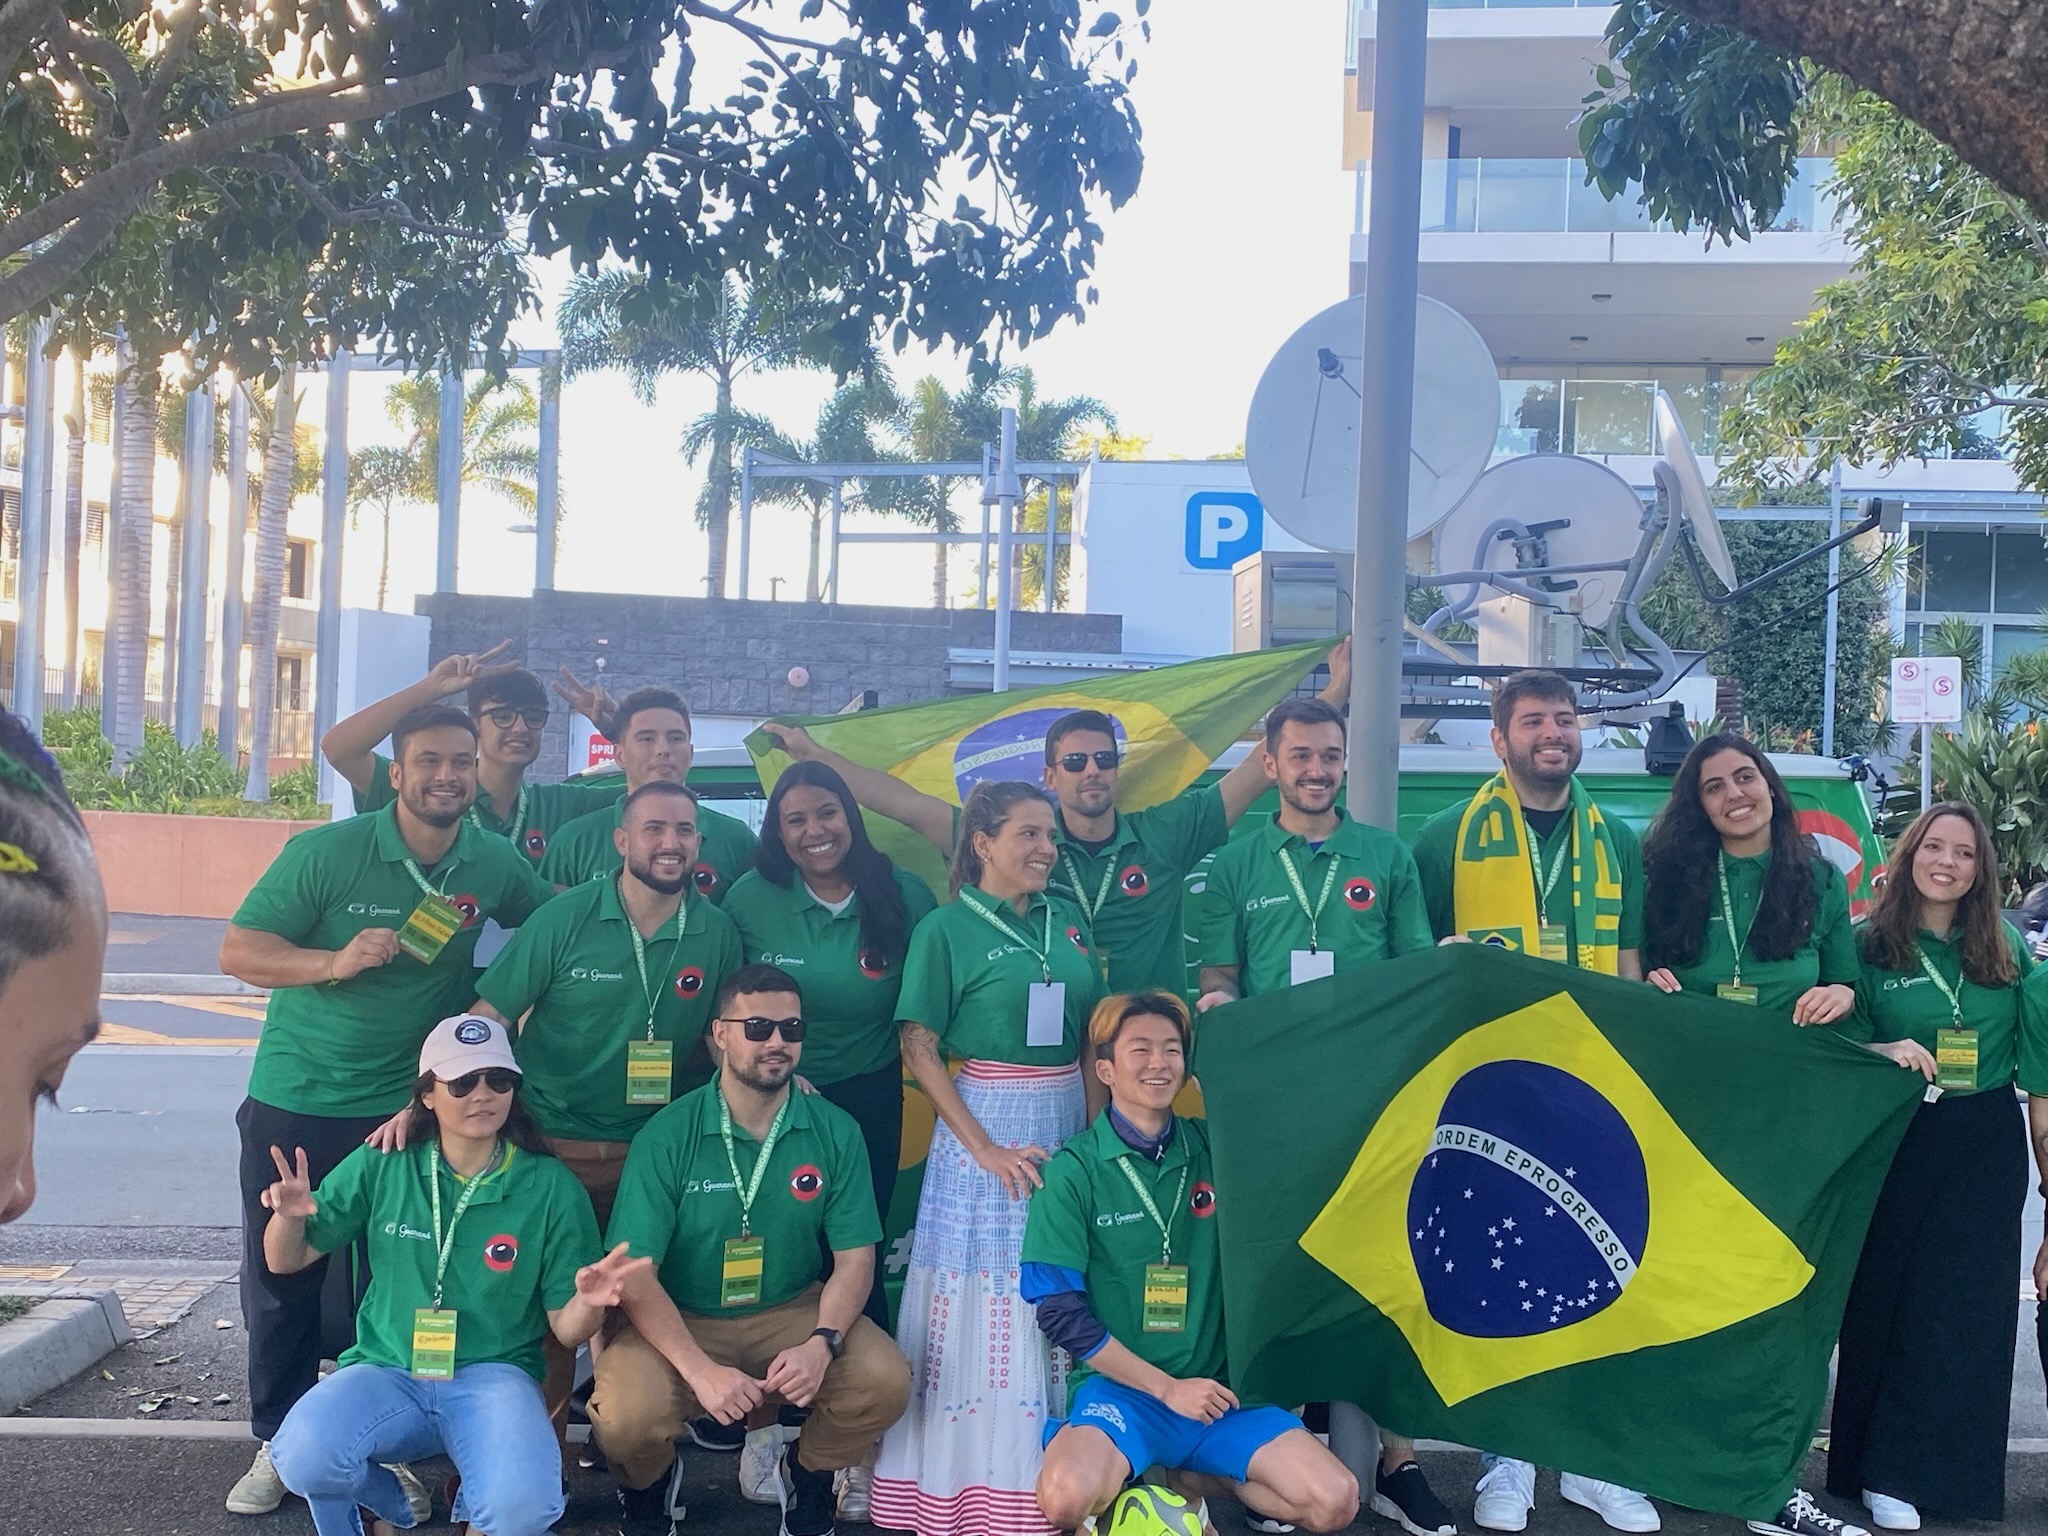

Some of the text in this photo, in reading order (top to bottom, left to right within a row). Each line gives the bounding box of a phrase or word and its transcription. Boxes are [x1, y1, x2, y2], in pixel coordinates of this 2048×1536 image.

[1199, 504, 1248, 558] P
[591, 744, 614, 754] SPRI
[1436, 1130, 1496, 1156] ORDEM
[1081, 1407, 1127, 1434] adidas
